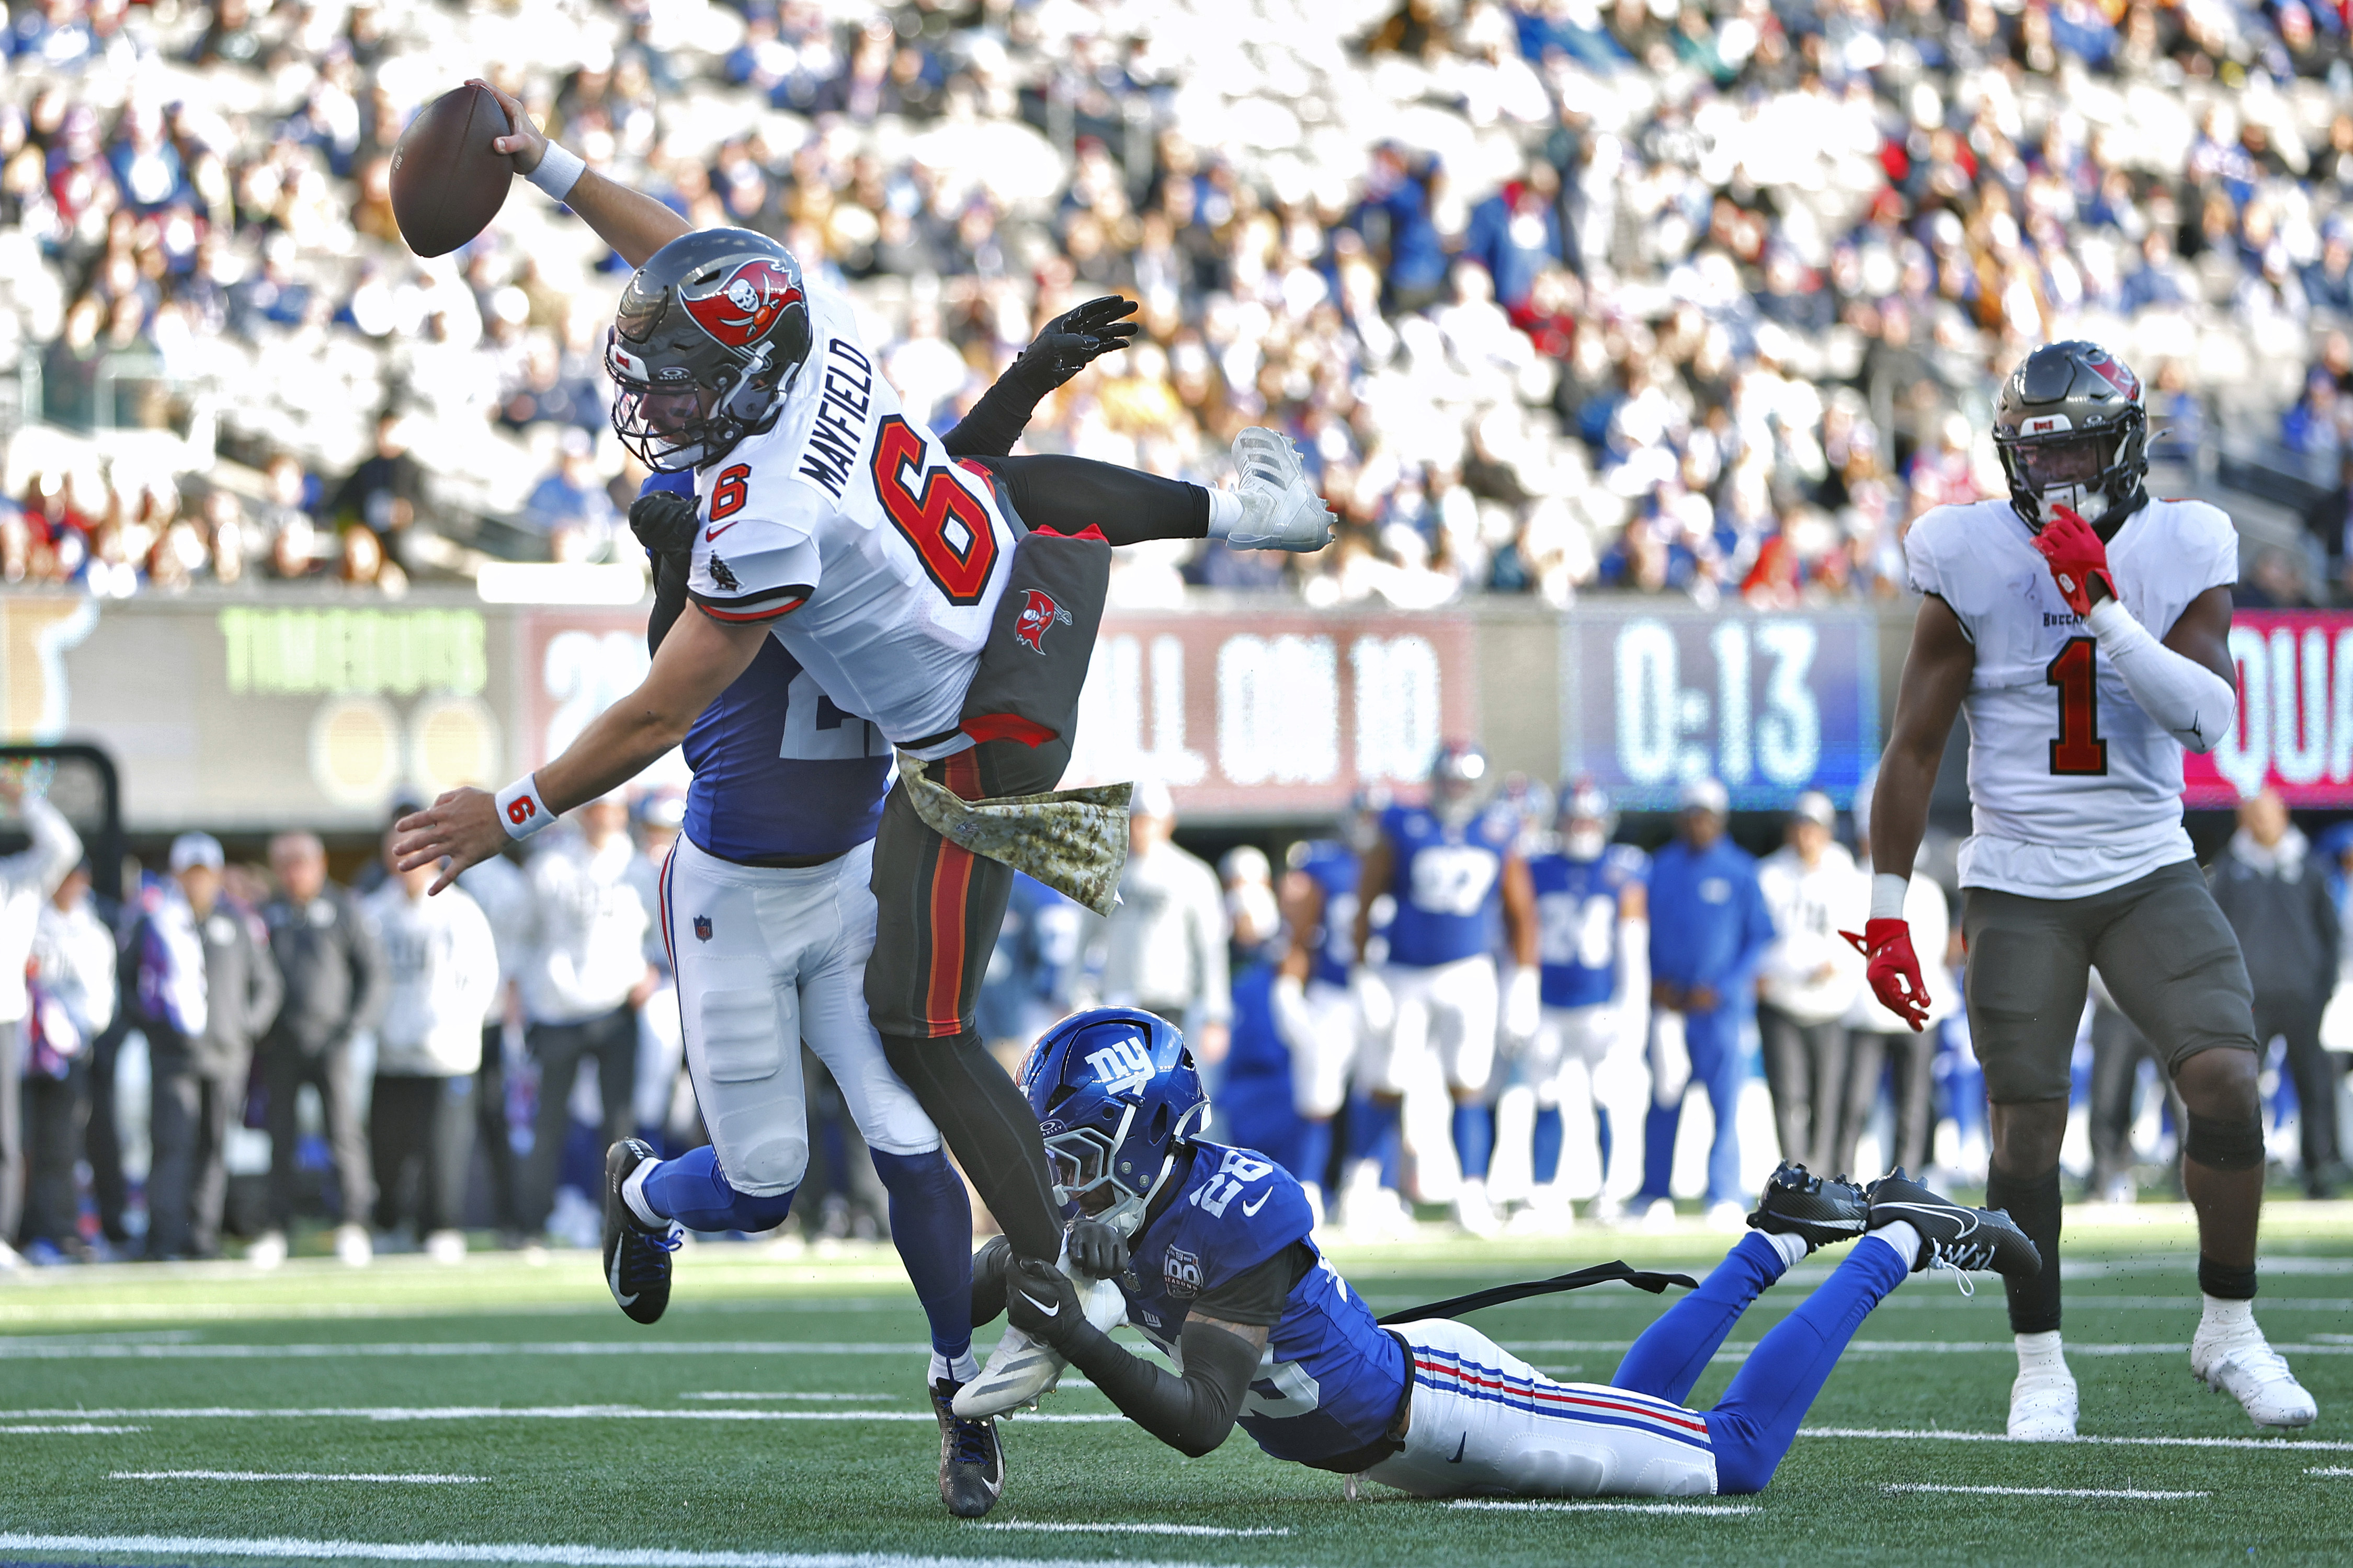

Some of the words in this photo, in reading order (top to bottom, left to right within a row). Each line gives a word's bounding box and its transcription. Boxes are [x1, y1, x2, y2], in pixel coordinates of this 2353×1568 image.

[799, 338, 872, 500] MAYFIELD
[709, 463, 751, 522] 6
[870, 414, 998, 605] 6
[2043, 613, 2084, 626] BUCCA
[1612, 617, 1822, 786] 0:13
[2047, 636, 2108, 776] 1
[507, 795, 536, 825] 6
[1042, 1125, 1062, 1137] AKLEY
[1189, 1150, 1274, 1219] 28
[1163, 1254, 1201, 1286] 100
